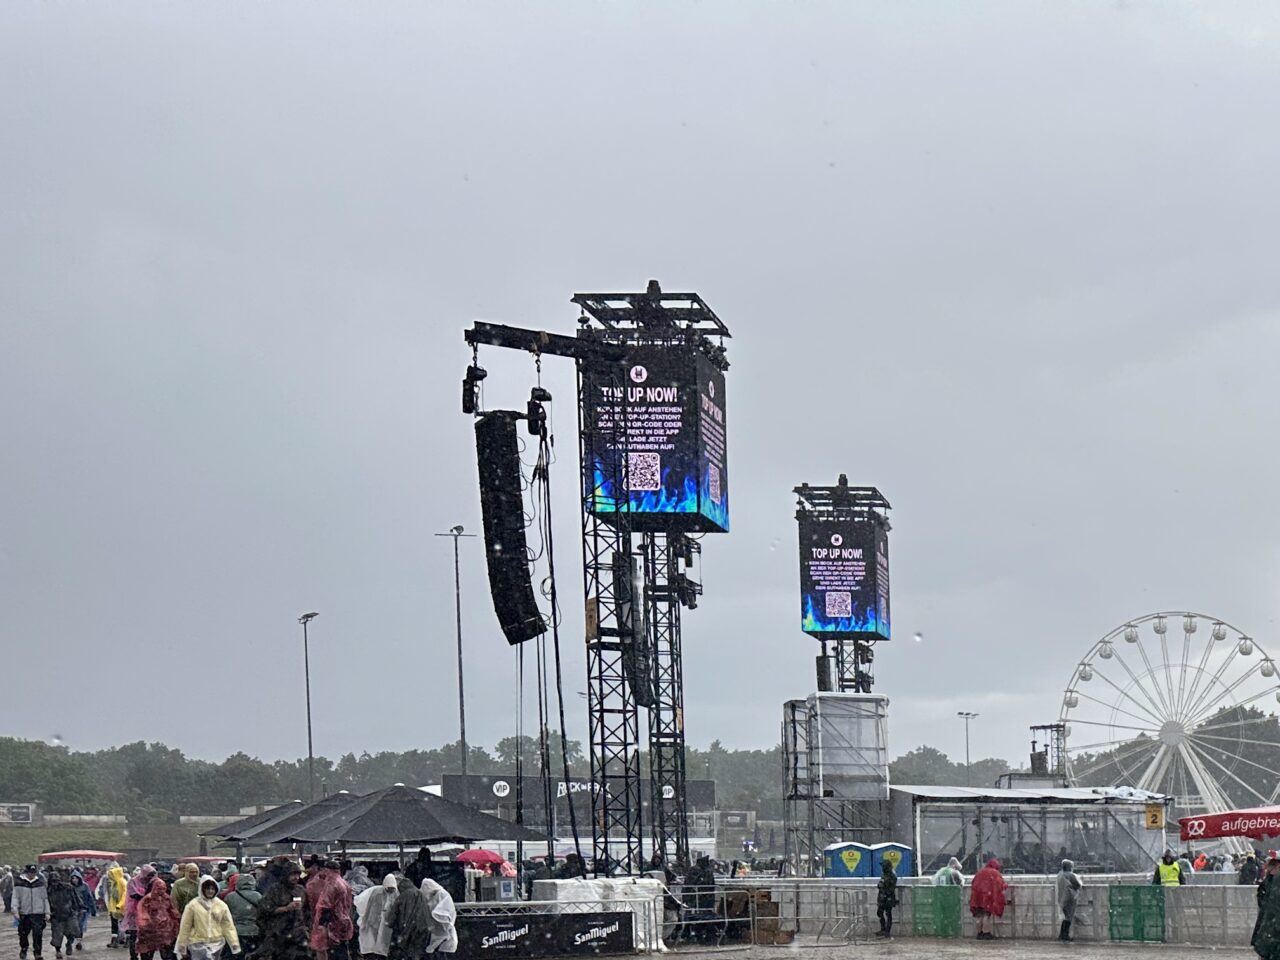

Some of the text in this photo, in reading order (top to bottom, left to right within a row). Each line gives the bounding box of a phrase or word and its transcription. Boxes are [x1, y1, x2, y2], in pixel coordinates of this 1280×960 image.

[627, 387, 644, 402] UP
[646, 387, 678, 402] NOW!
[812, 548, 863, 559] TOP UP NOW!
[495, 785, 507, 793] VIP
[1151, 814, 1158, 824] 2
